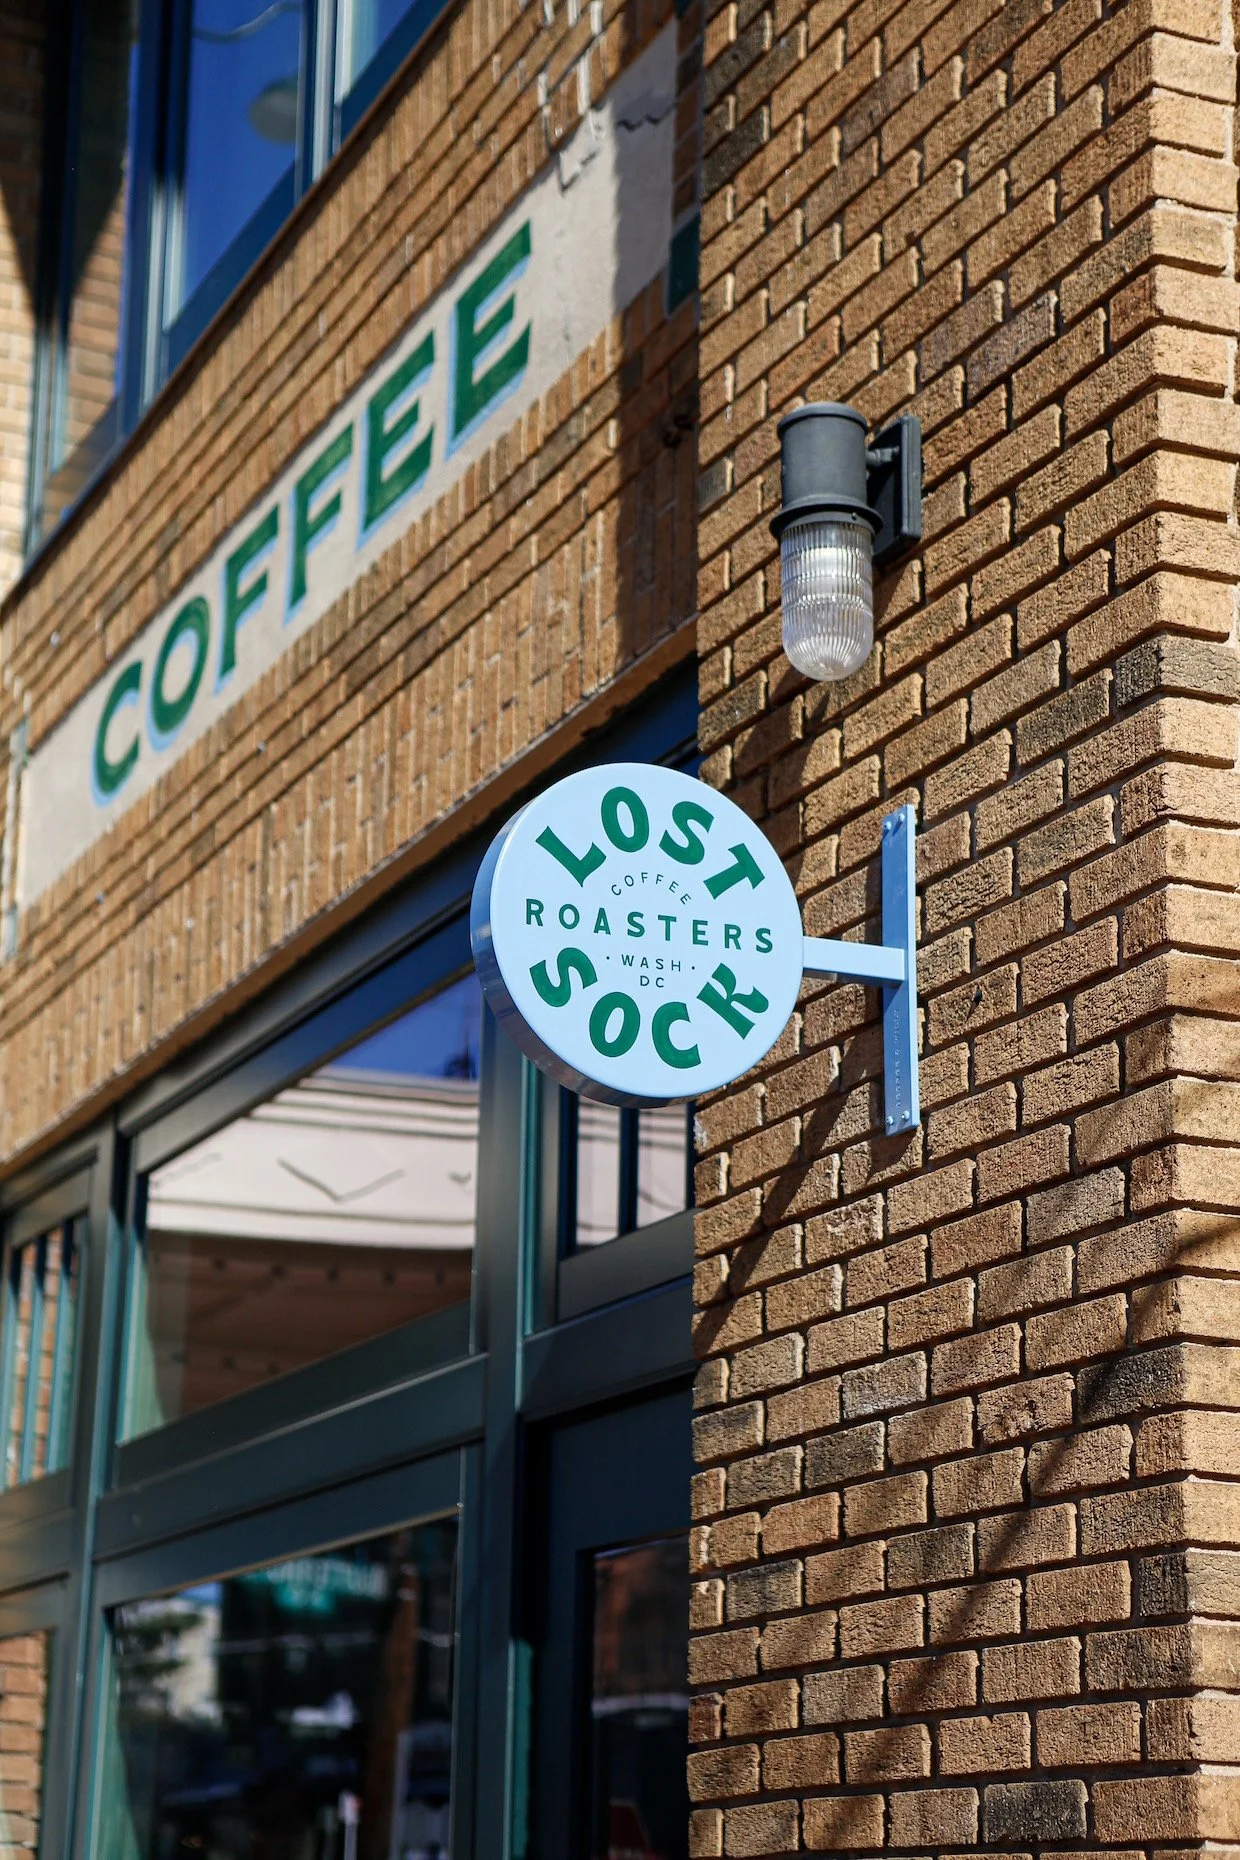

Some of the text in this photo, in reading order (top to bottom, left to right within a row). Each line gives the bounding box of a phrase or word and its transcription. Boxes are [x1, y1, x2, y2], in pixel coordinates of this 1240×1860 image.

[94, 219, 533, 803] COFFEE
[535, 786, 765, 900] LOST
[611, 872, 691, 905] COFFEE
[526, 899, 774, 953] ROASTERS
[620, 953, 682, 973] WASH
[639, 975, 665, 989] DC
[529, 947, 769, 1069] SOCK
